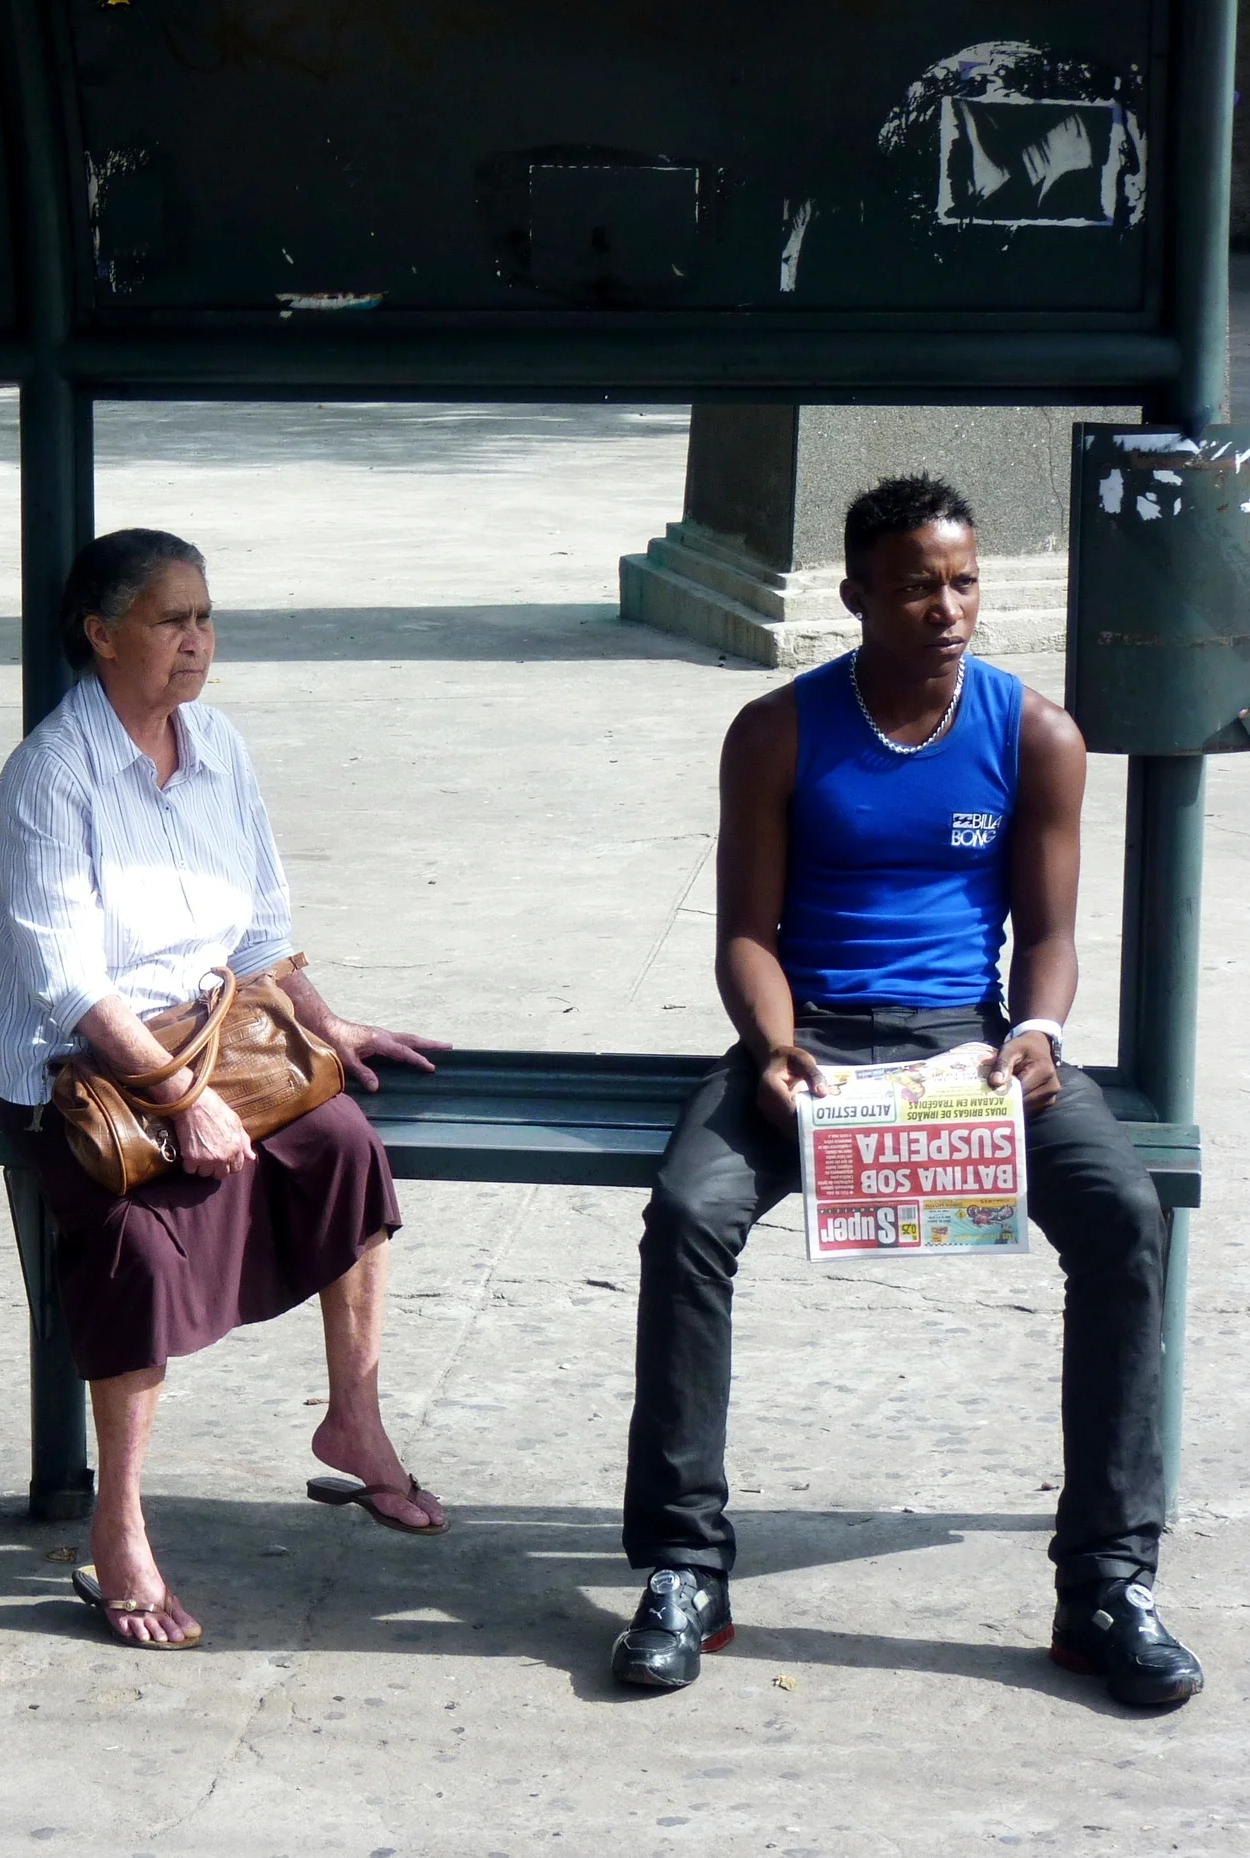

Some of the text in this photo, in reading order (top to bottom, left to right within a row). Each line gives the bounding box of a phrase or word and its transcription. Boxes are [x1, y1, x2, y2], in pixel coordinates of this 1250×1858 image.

[972, 814, 1003, 829] BILLA
[952, 830, 996, 847] BONG
[956, 1099, 968, 1107] EM
[970, 1098, 1004, 1107] ACABAM
[816, 1104, 891, 1119] ALTO ESTILO
[907, 1107, 1007, 1122] DUAS BRIGAS DE IRMÃOS
[856, 1127, 1012, 1164] SUSPEITA
[861, 1165, 1013, 1194] BATINA SOB
[820, 1207, 897, 1245] Super
